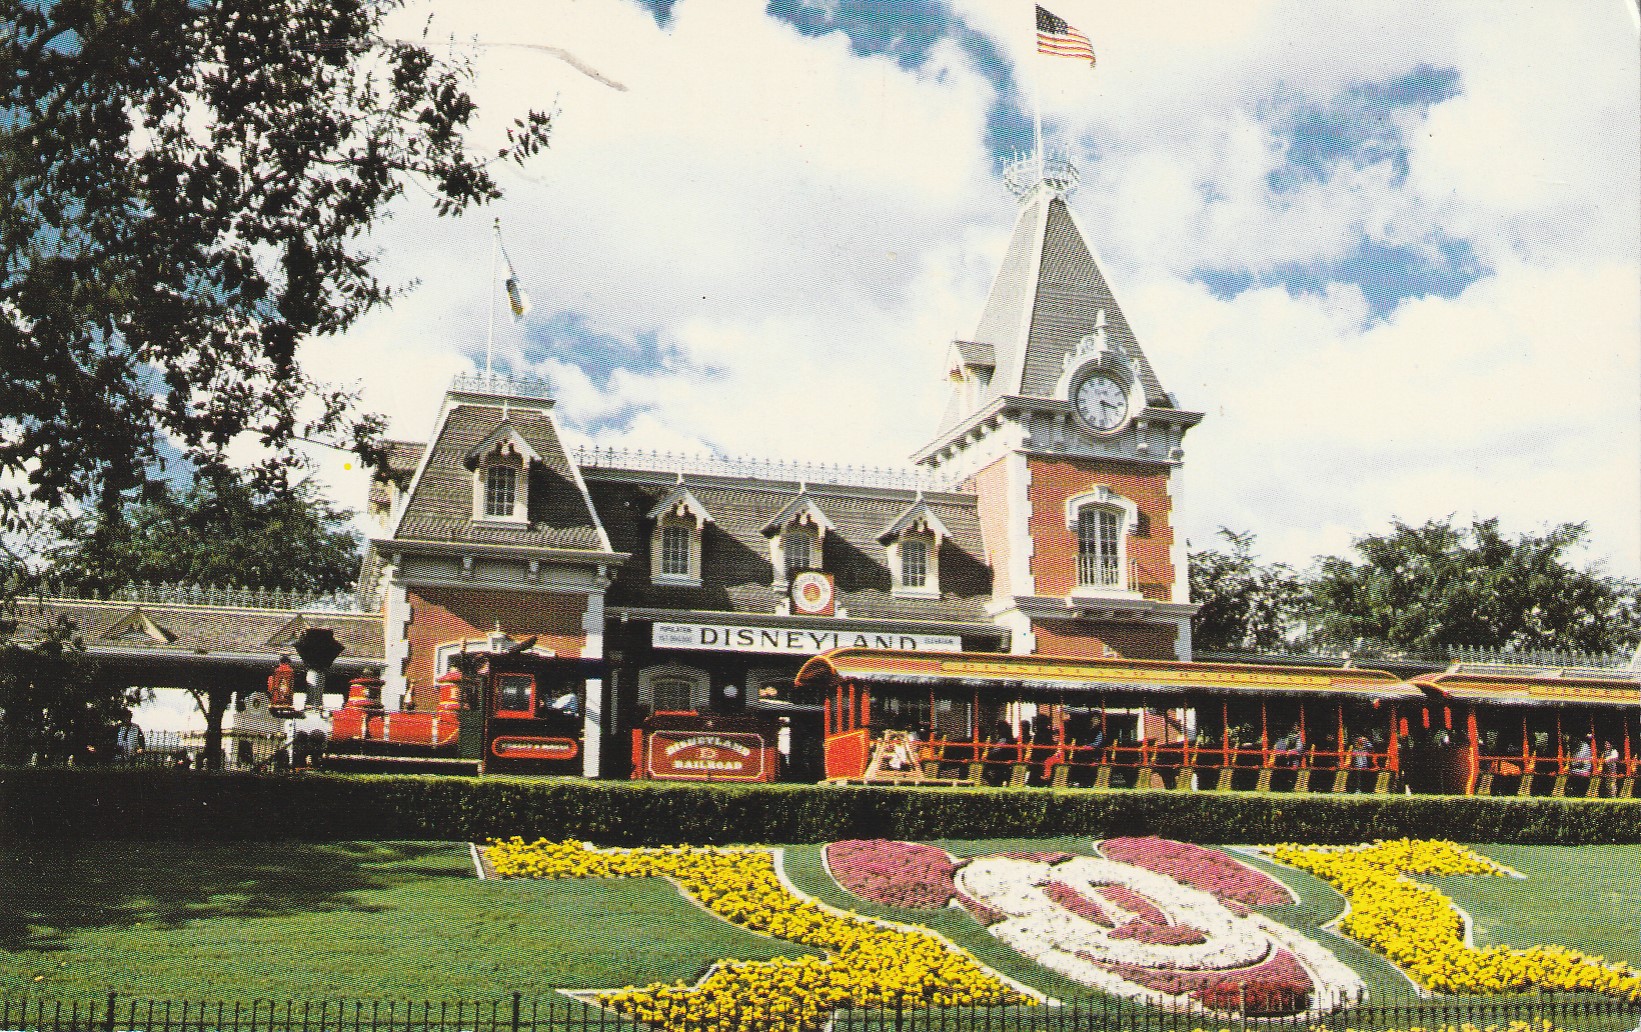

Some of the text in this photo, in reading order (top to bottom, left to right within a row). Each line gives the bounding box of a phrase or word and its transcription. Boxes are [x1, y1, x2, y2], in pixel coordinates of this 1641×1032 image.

[700, 627, 917, 650] DISNEYLAND
[665, 736, 750, 756] DISNEYLAND
[674, 760, 743, 770] RAILROAD
